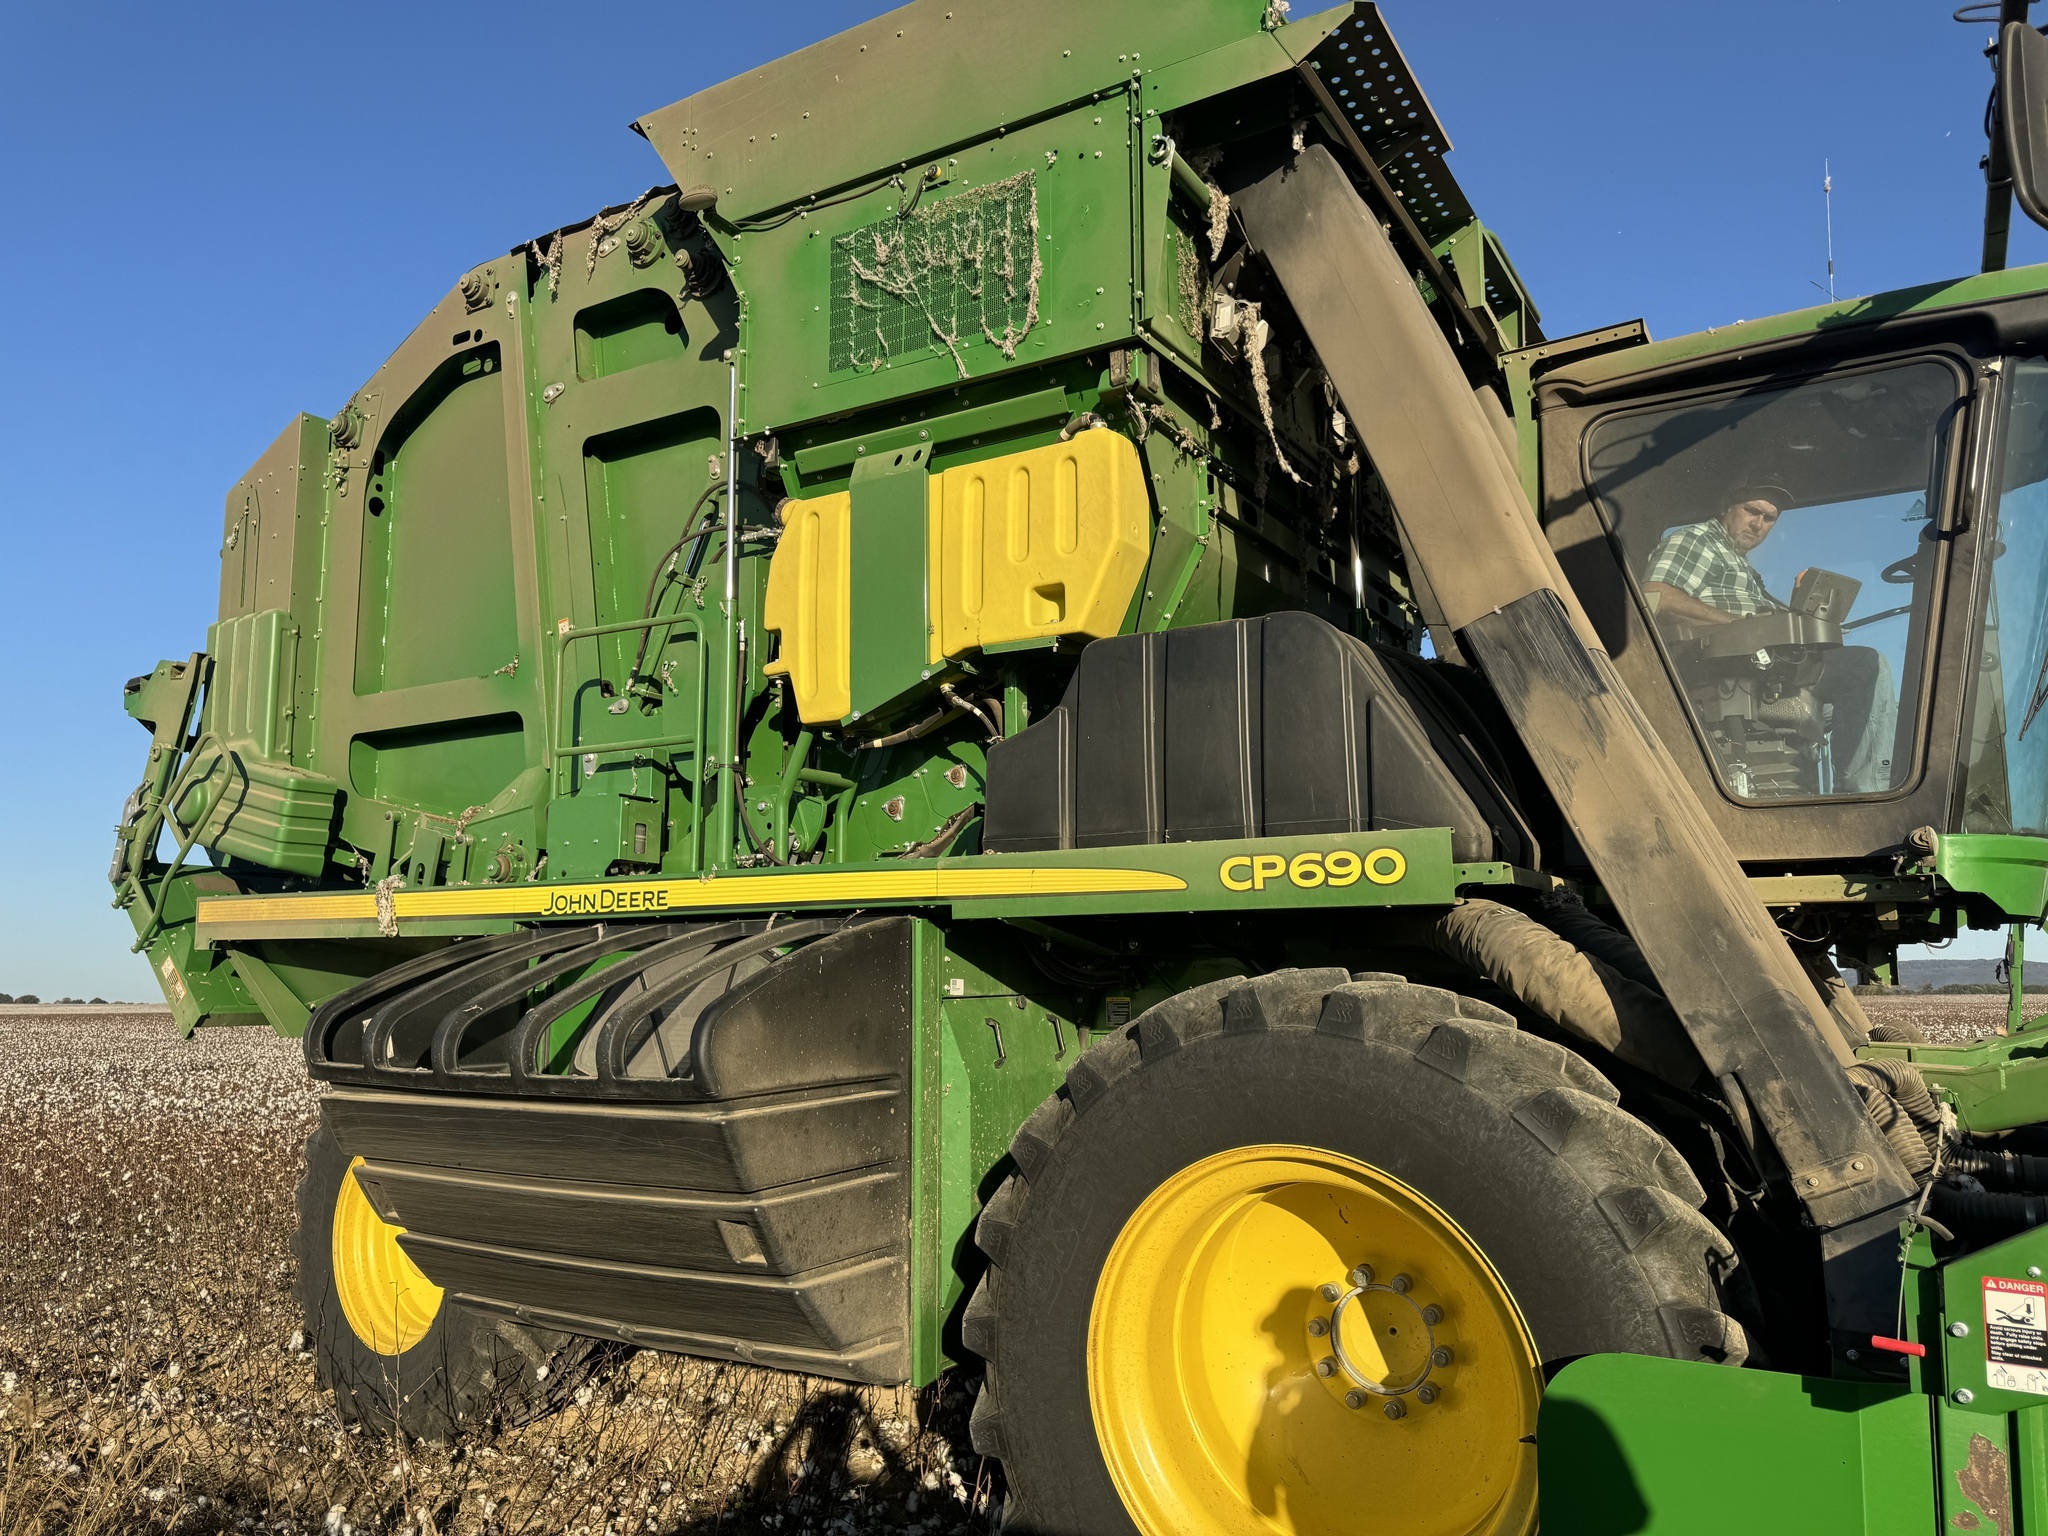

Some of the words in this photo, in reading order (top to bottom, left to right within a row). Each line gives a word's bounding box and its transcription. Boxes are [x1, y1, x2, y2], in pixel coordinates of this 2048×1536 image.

[1219, 847, 1407, 891] CP690
[543, 891, 596, 912] JOHN
[600, 889, 669, 909] DEERE
[1998, 1280, 2044, 1294] DANGER
